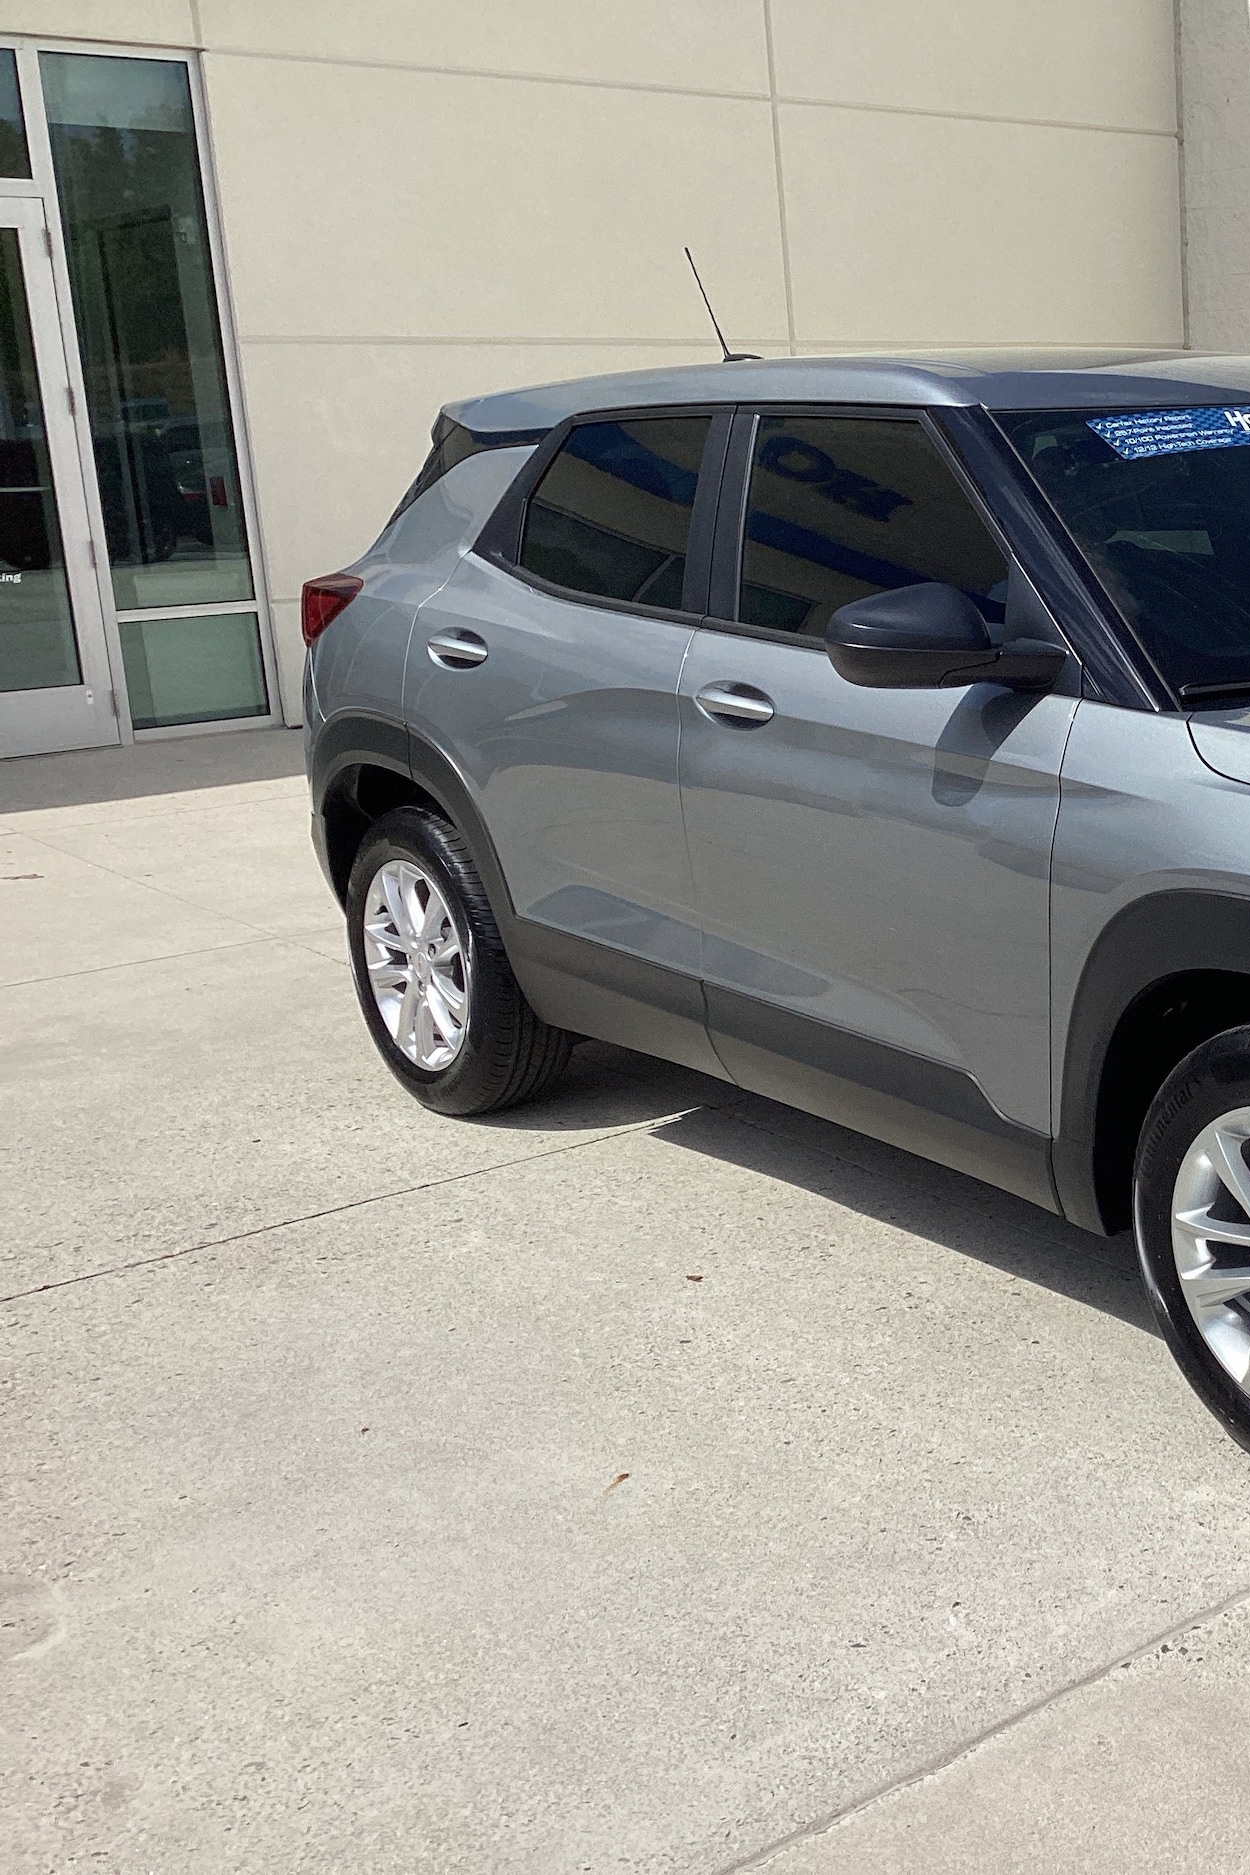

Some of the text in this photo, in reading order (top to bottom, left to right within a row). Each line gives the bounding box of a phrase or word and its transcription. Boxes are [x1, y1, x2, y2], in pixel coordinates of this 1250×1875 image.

[1105, 421, 1133, 429] Carfax
[1134, 418, 1162, 426] History
[1124, 435, 1154, 445] 10/100
[1155, 431, 1198, 441] Powertrain
